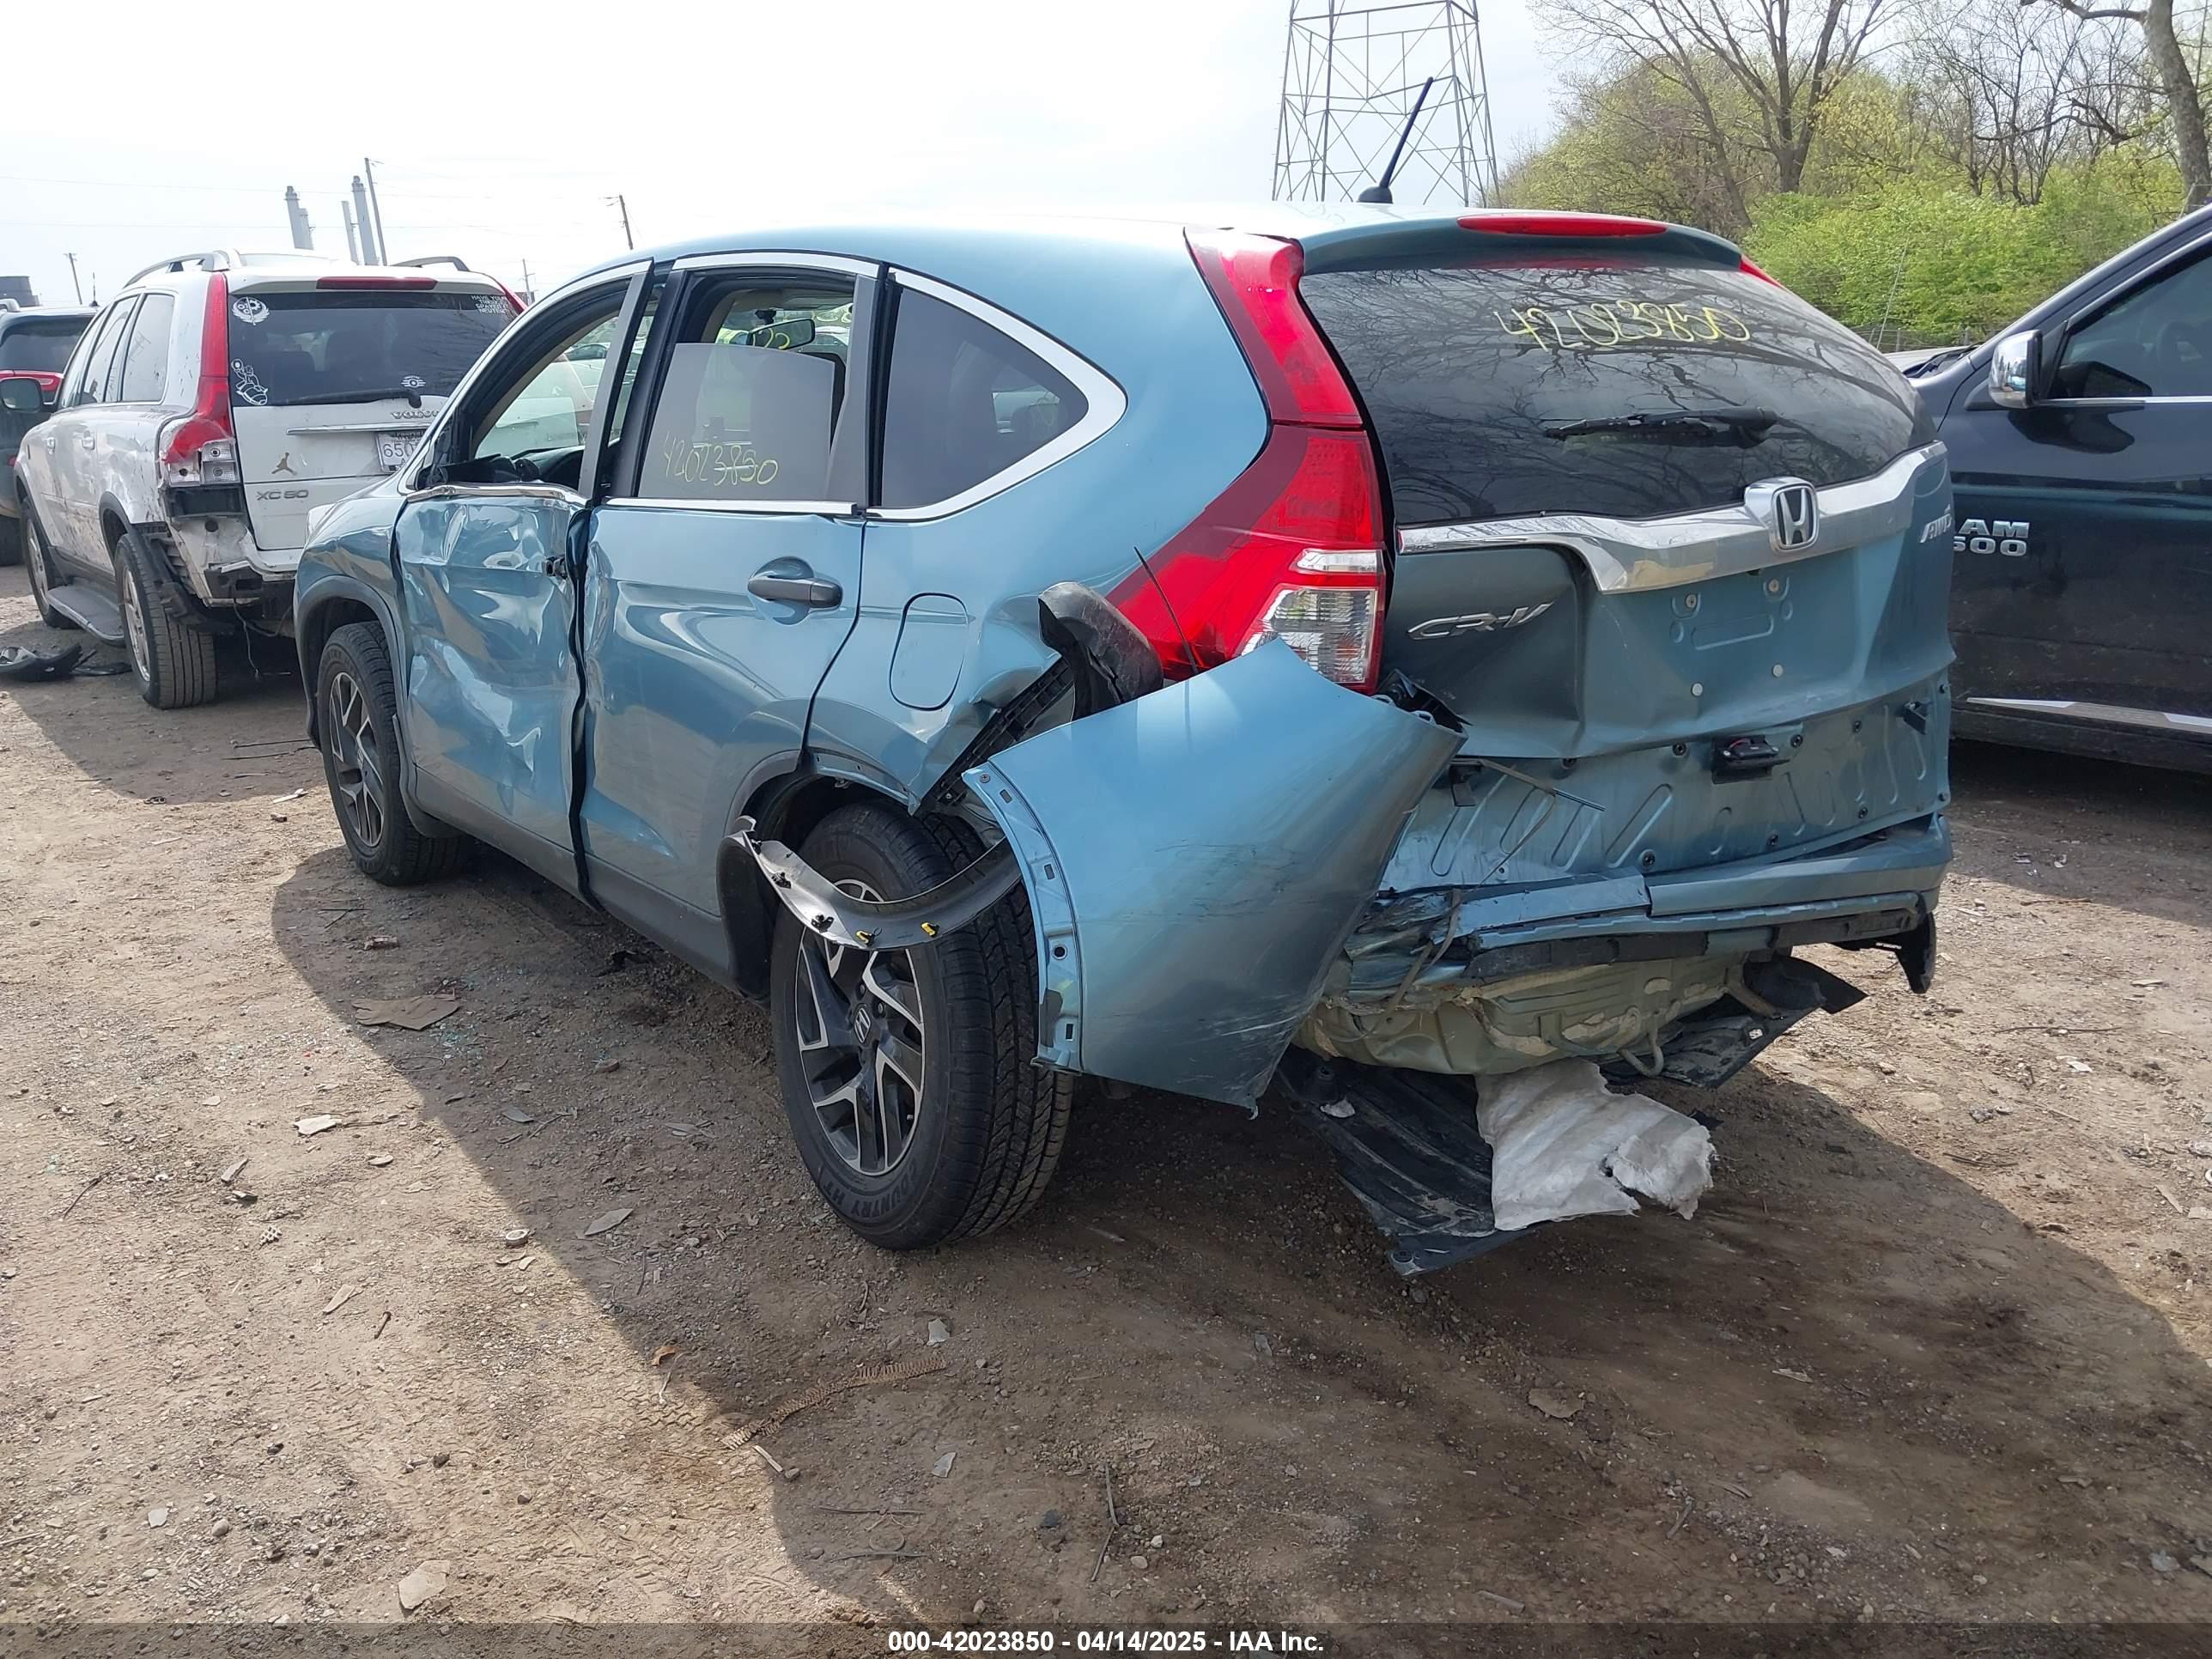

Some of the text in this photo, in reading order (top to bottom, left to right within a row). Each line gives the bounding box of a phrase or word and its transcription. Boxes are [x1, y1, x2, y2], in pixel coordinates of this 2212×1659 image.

[1493, 300, 1751, 352] 42023850
[664, 433, 779, 486] 42023850
[1953, 536, 2027, 557] 500
[1958, 518, 2031, 538] AM
[1407, 600, 1554, 641] CR-V
